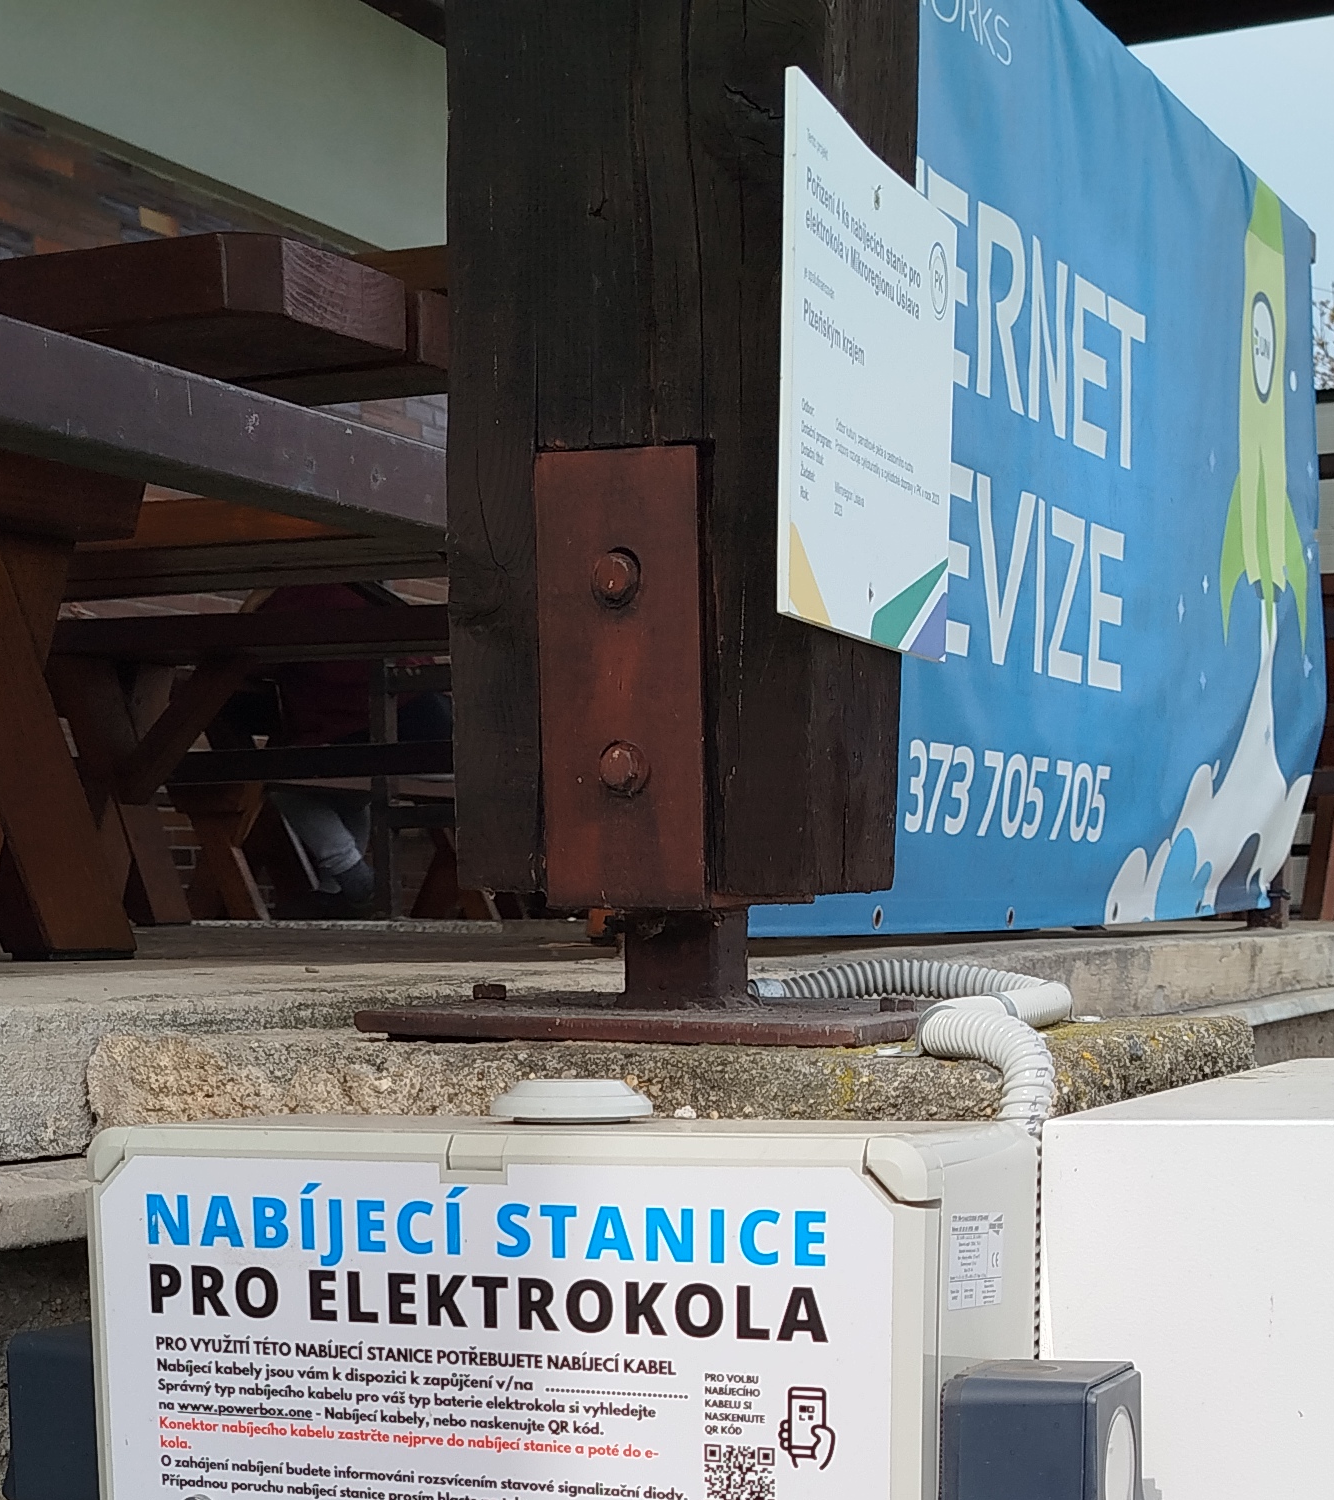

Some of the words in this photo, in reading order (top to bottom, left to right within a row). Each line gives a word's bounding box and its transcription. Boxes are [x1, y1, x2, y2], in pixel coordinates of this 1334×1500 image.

[842, 202, 849, 229] ks
[886, 246, 907, 278] stanic
[909, 268, 921, 288] pro
[904, 739, 974, 835] 373
[976, 750, 1049, 839] 705
[1049, 760, 1111, 843] 705
[146, 1182, 469, 1266] NABÍJECÍ
[496, 1202, 827, 1267] STANICE
[149, 1263, 279, 1319] PRO
[308, 1269, 829, 1343] ELEKTROKOLA
[156, 1336, 187, 1351] PRO
[190, 1334, 250, 1354] VYUŽITÍ
[253, 1336, 291, 1356] TÉTO
[295, 1339, 363, 1360] NABÍJECÍ
[367, 1346, 432, 1364] STANICE
[437, 1346, 543, 1369] POTŘEBUJETE
[547, 1351, 619, 1373] NABÍJECÍ
[623, 1359, 676, 1375] KABEL
[157, 1358, 212, 1377] Nabíjecí
[216, 1360, 262, 1381] kabely
[265, 1363, 294, 1380] jsou
[298, 1366, 329, 1380] vám
[333, 1366, 342, 1381] k
[345, 1367, 406, 1386] dispozici
[410, 1371, 421, 1385] k
[423, 1373, 494, 1391] zapůjčení
[496, 1375, 534, 1391] v/na
[704, 1373, 725, 1382] PRO
[726, 1374, 759, 1384] VOLBU
[704, 1384, 760, 1397] NABÍJECÍHO
[158, 1379, 211, 1396] Správný
[214, 1382, 235, 1397] typ
[238, 1384, 305, 1400] nabíjecího
[308, 1387, 353, 1401] kabelu
[356, 1392, 379, 1404] pro
[382, 1391, 406, 1404] váš
[409, 1394, 431, 1409] typ
[434, 1394, 483, 1409] baterie
[486, 1396, 565, 1413] elektrokola
[569, 1401, 580, 1414] si
[582, 1402, 656, 1420] vyhledejte
[704, 1399, 741, 1409] KABELU
[743, 1401, 752, 1410] SI
[704, 1412, 765, 1423] NASKENUJTE
[158, 1400, 175, 1411] na
[177, 1402, 313, 1421] www.powerbox.one
[324, 1407, 377, 1426] Nabíjecí
[380, 1409, 430, 1428] kabely,
[433, 1415, 467, 1428] nebo
[470, 1417, 545, 1435] naskenujte
[548, 1421, 570, 1435] QR
[573, 1421, 604, 1436] kód.
[704, 1425, 719, 1435] QR
[721, 1424, 742, 1435] KÓD
[159, 1417, 219, 1432] Konektor
[222, 1420, 287, 1437] nabíjecího
[290, 1424, 335, 1439] kabelu
[338, 1427, 390, 1442] zastrčte
[393, 1433, 444, 1449] nejprve
[447, 1434, 465, 1447] do
[468, 1435, 521, 1452] nabíjecí
[523, 1440, 571, 1454] stanice
[575, 1445, 584, 1454] a
[588, 1443, 619, 1459] poté
[623, 1444, 642, 1458] do
[645, 1449, 659, 1458] e-
[160, 1435, 192, 1450] kola.
[161, 1455, 171, 1466] O
[174, 1455, 229, 1471] zahájení
[232, 1458, 284, 1476] nabíjení
[286, 1462, 331, 1478] budete
[334, 1466, 415, 1483] informováni
[418, 1472, 497, 1489] rozsvícením
[501, 1478, 554, 1493] stavové
[558, 1480, 642, 1499] signalizační
[161, 1473, 228, 1490] Případnou
[231, 1479, 284, 1494] poruchu
[287, 1482, 336, 1500] nabíjecí
[340, 1487, 385, 1500] stanice
